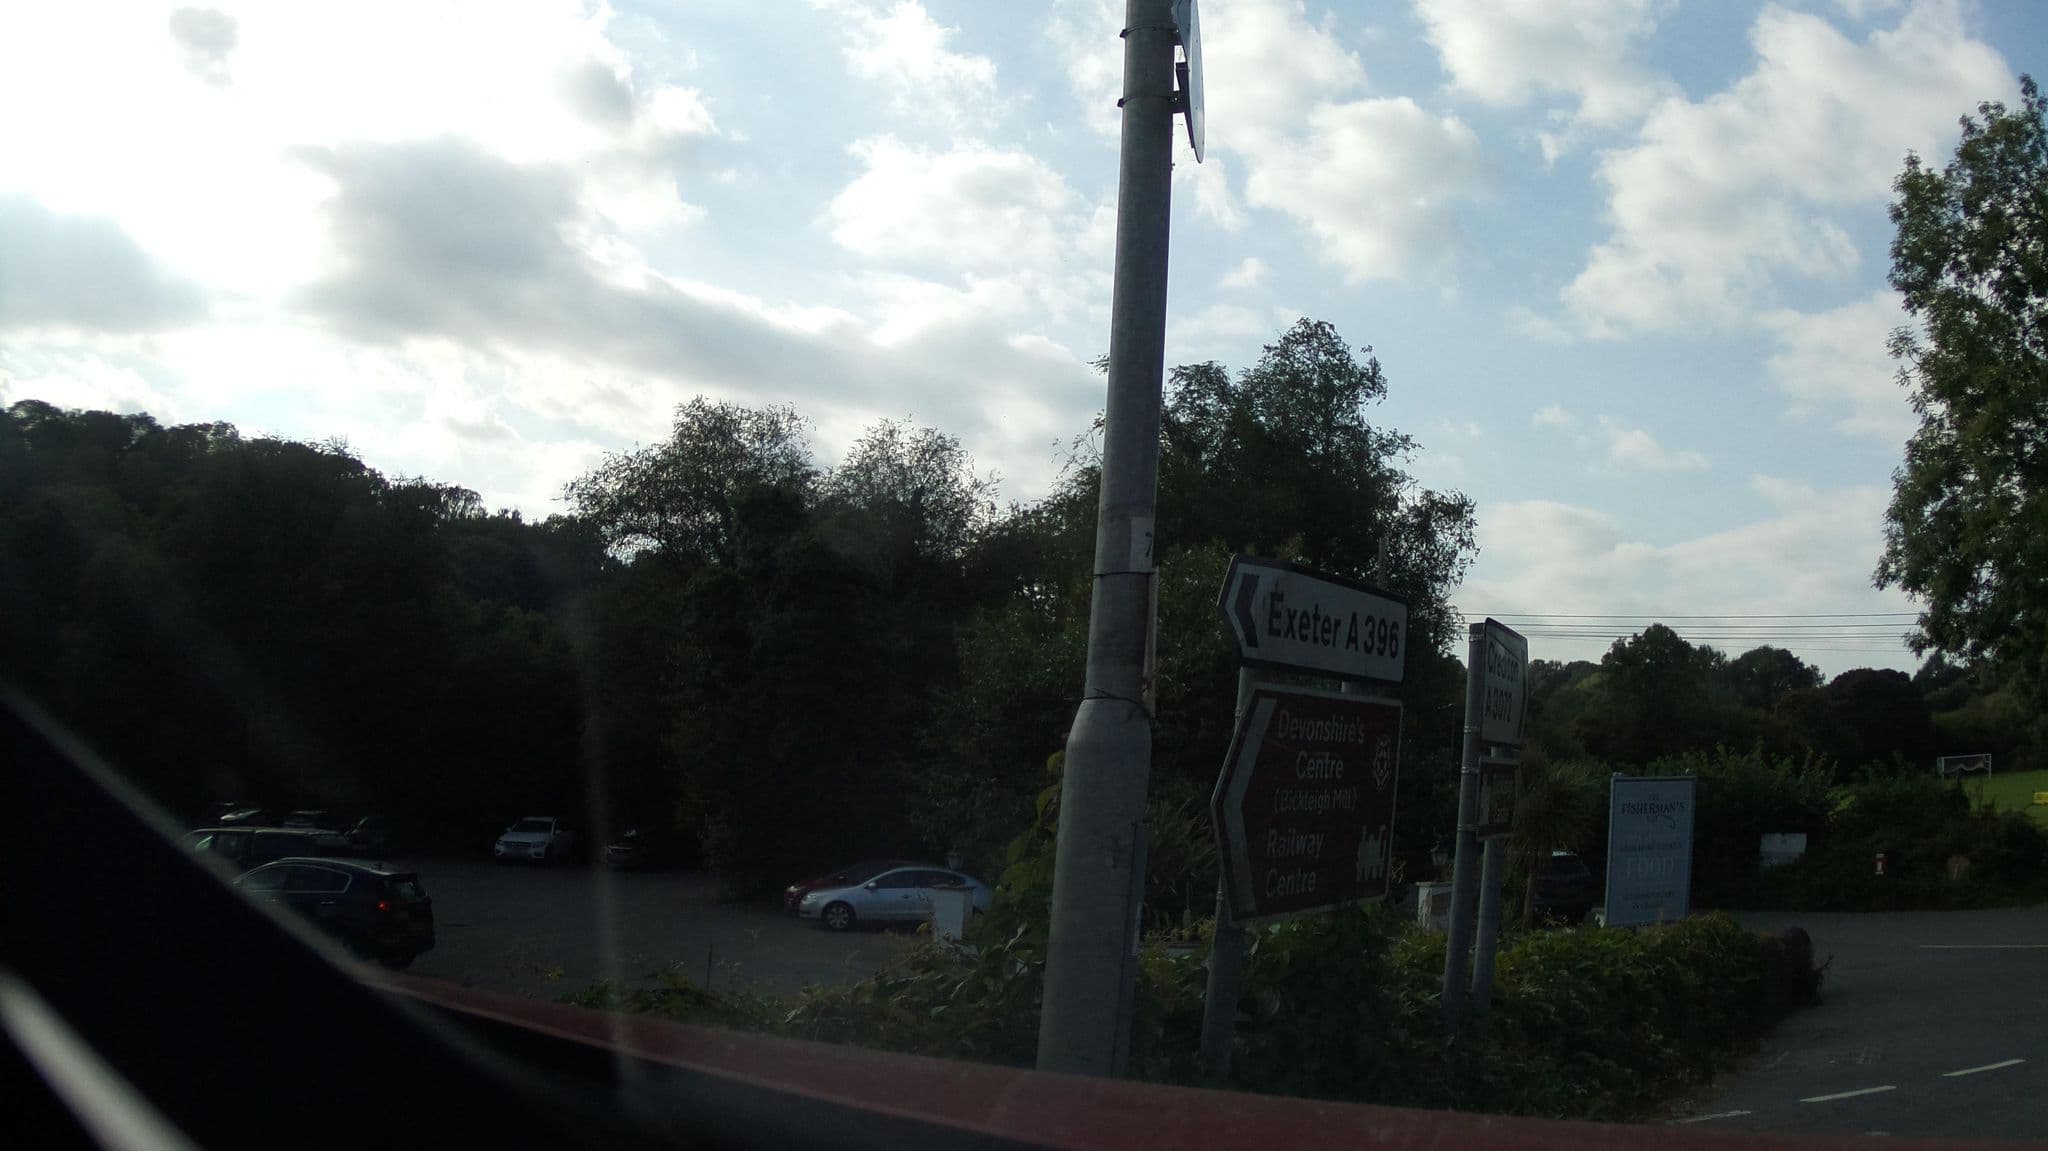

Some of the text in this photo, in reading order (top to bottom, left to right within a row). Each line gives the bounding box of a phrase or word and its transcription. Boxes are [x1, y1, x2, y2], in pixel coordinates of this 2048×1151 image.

[1267, 590, 1342, 647] Exeter
[1278, 708, 1366, 745] Devonshire's
[1295, 750, 1345, 780] Centre
[1266, 826, 1325, 859] Railway
[1265, 867, 1318, 898] Centre
